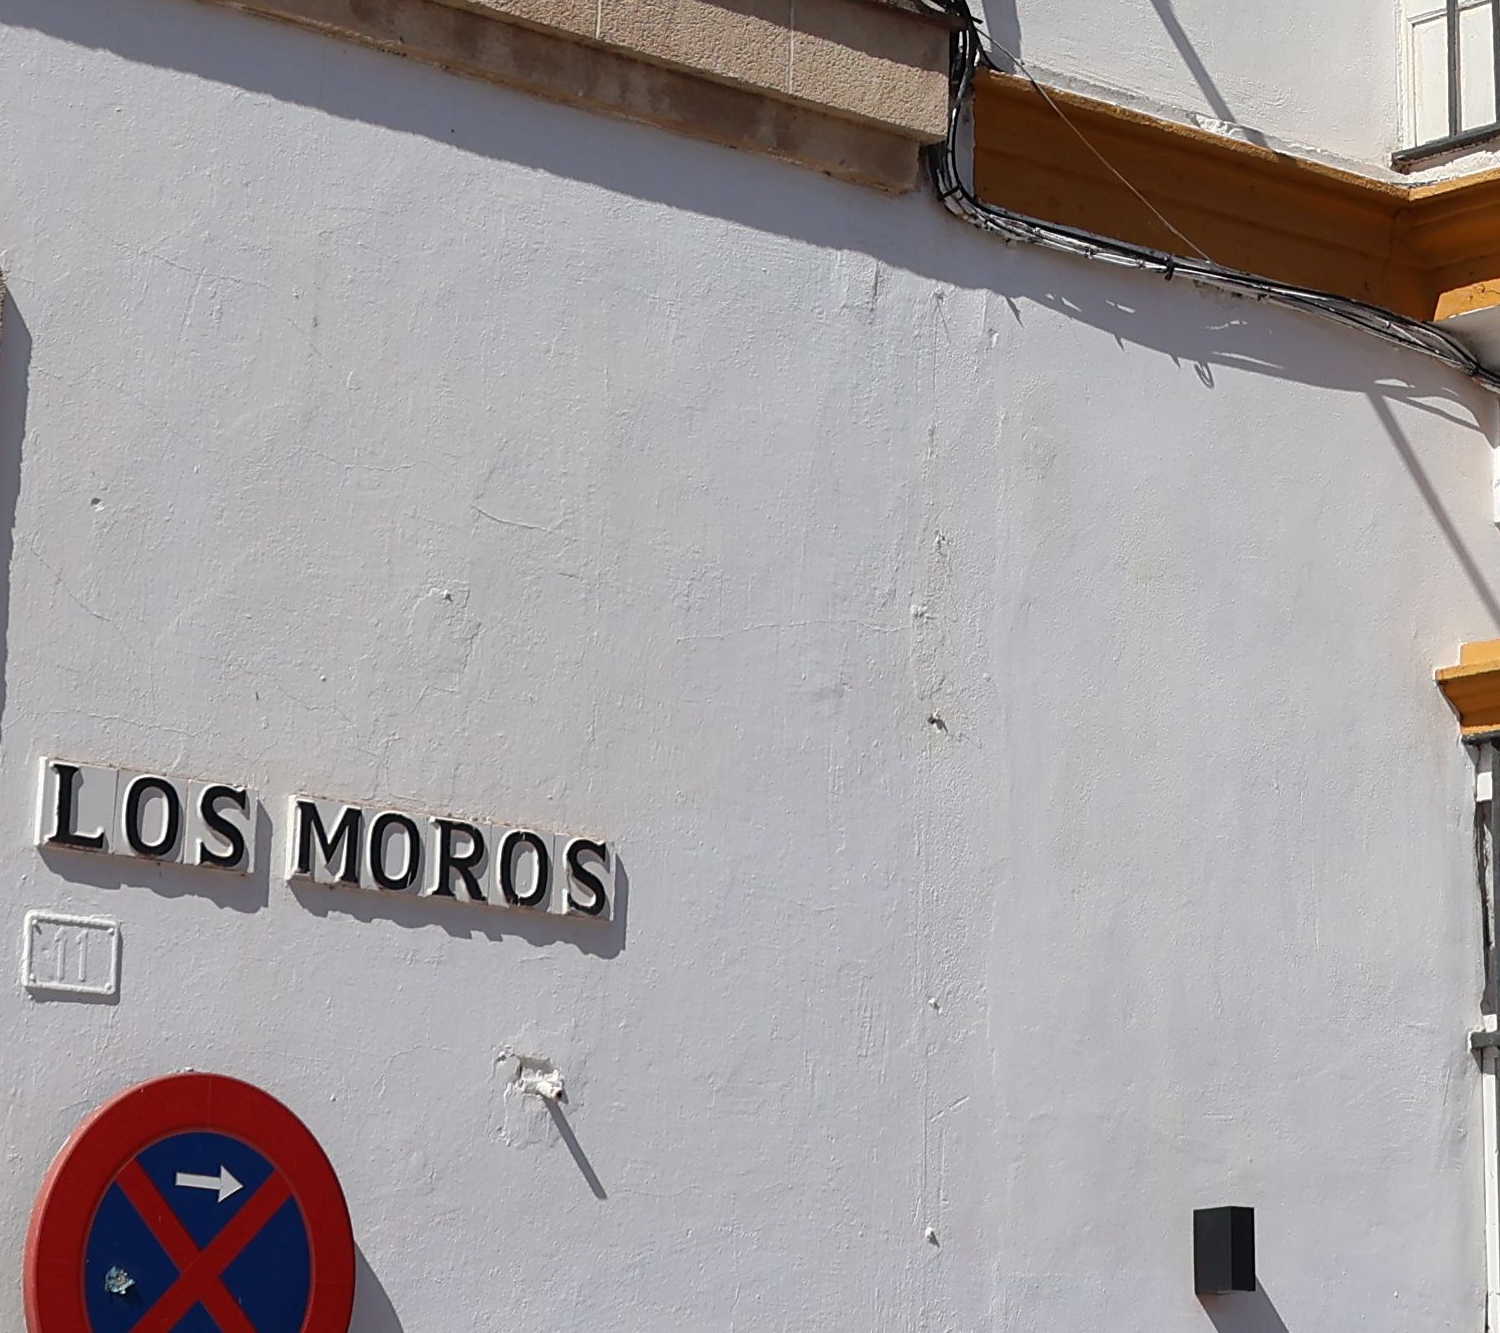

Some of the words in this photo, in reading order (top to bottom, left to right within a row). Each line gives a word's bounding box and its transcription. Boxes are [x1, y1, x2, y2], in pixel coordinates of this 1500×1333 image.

[48, 763, 247, 867] LOS
[296, 799, 607, 916] MOROS
[54, 925, 89, 982] 11
